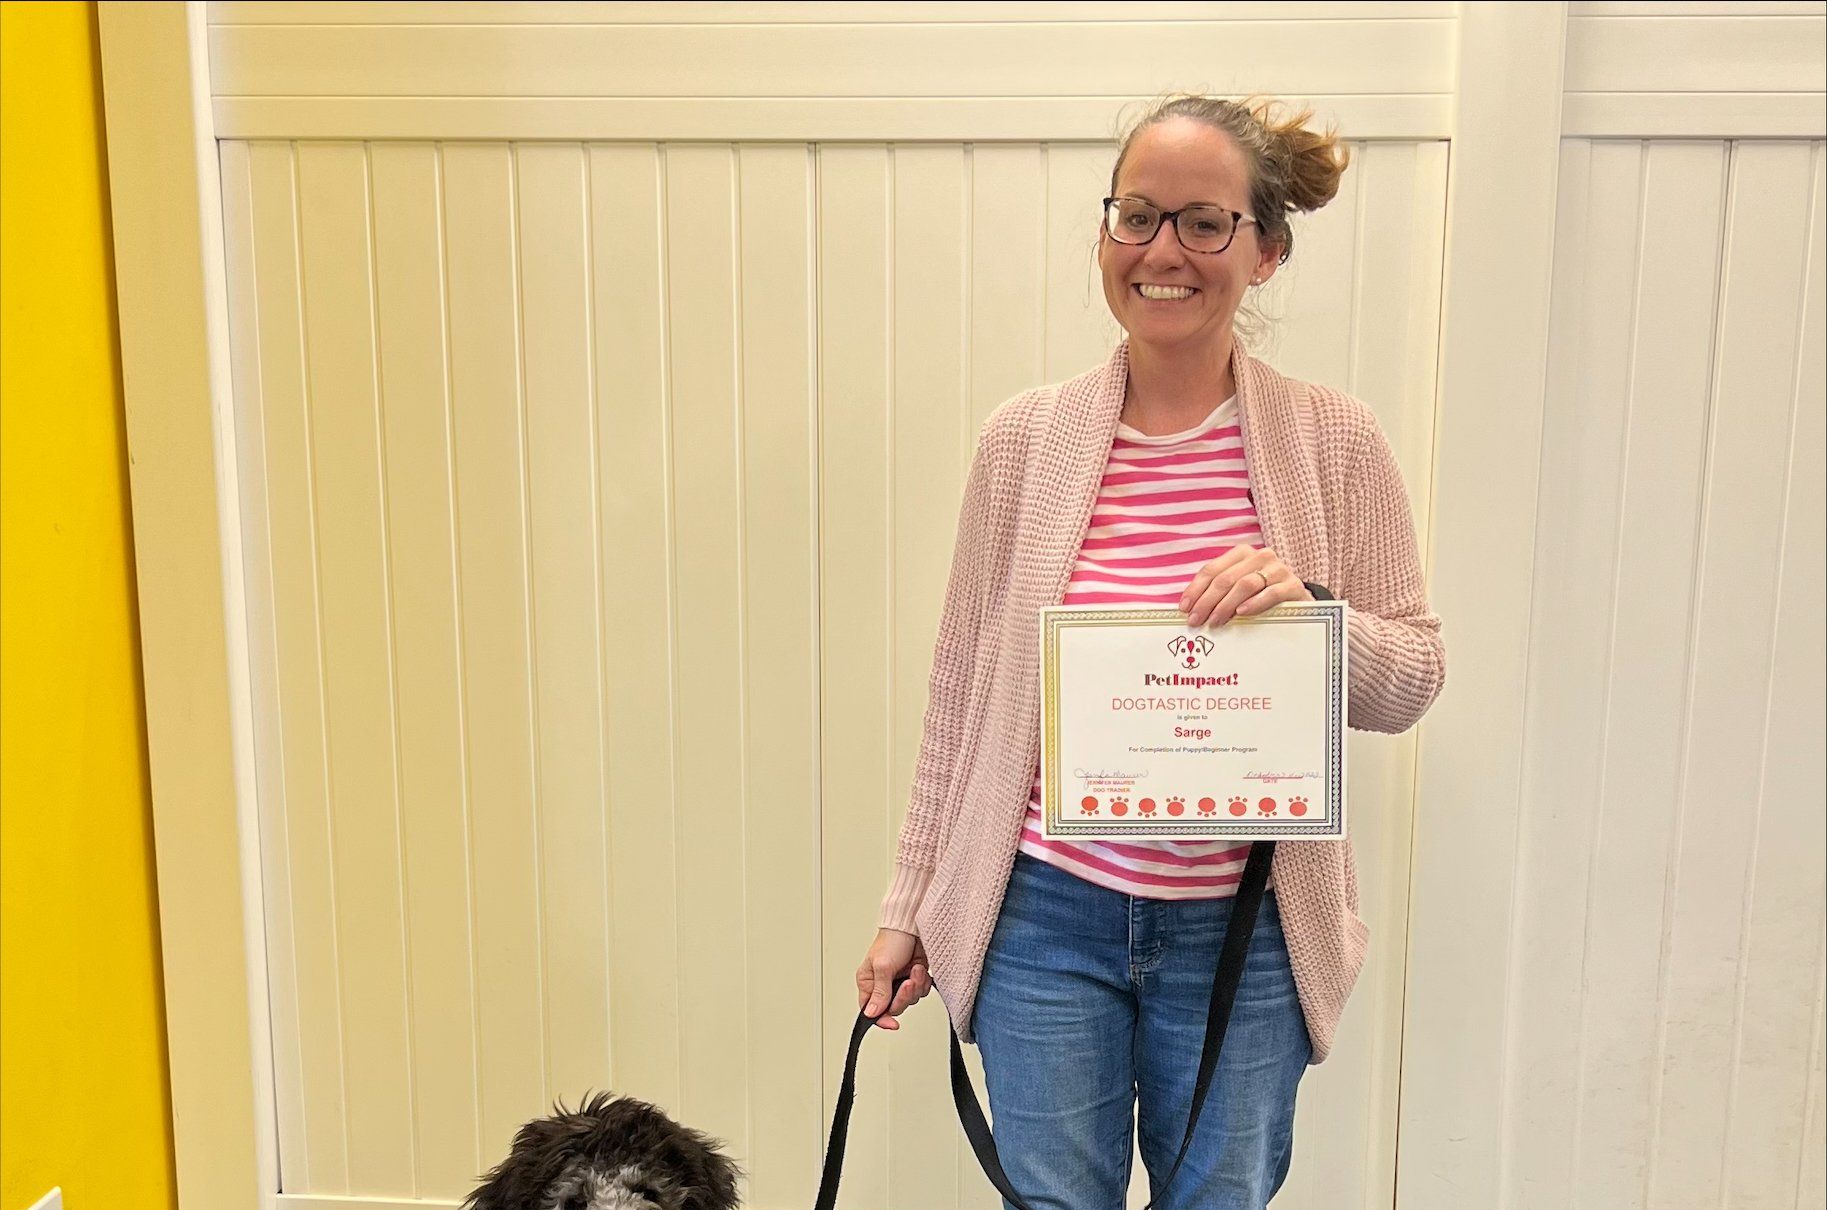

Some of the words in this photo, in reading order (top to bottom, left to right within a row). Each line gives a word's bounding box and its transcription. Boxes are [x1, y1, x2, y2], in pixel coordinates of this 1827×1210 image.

[1144, 673, 1239, 689] PetImpact!
[1112, 697, 1201, 711] DOGTASTIC
[1206, 697, 1272, 710] DEGREE
[1174, 726, 1211, 740] Sarge
[1140, 746, 1174, 754] Completion
[1231, 746, 1258, 754] Program
